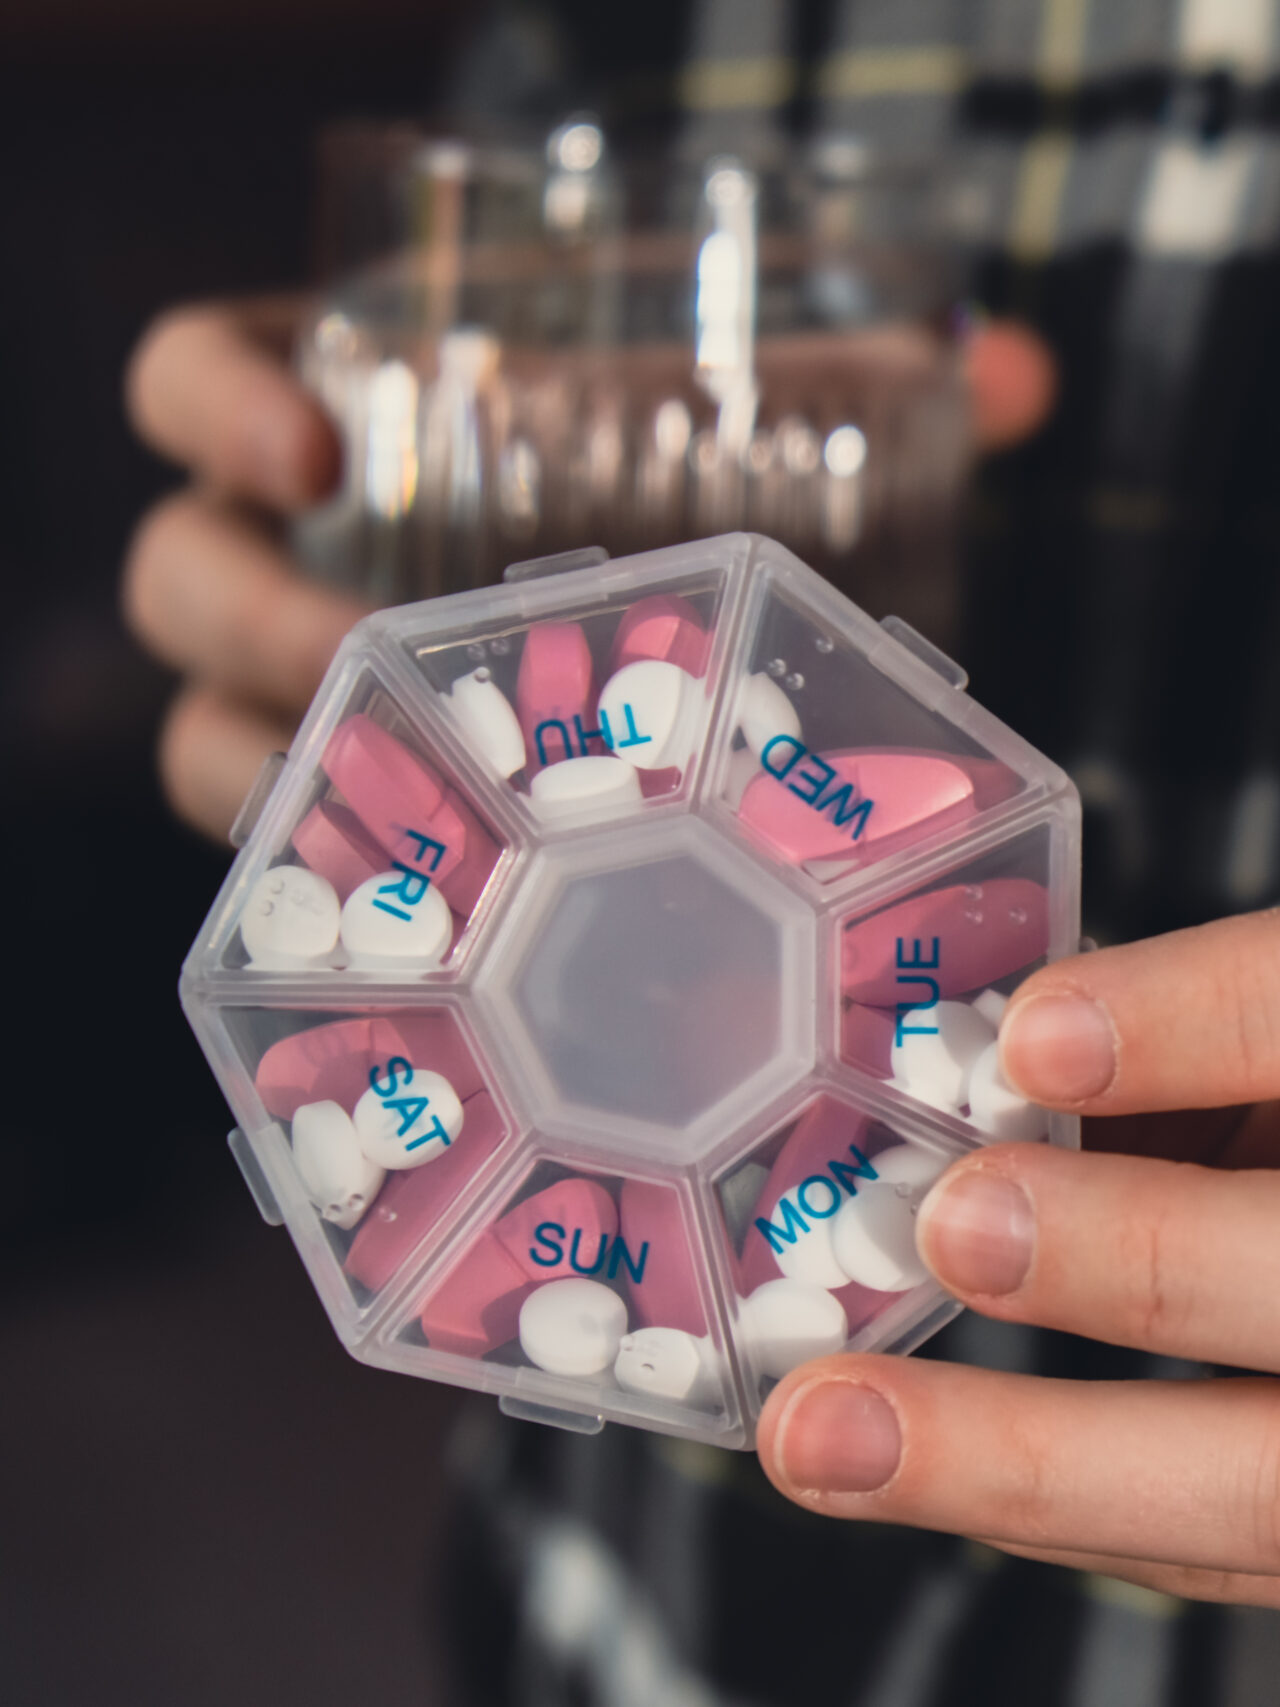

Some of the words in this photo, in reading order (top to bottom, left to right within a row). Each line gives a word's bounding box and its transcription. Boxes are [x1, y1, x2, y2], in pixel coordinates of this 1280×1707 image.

[533, 703, 652, 765] THU
[760, 734, 874, 841] WED
[372, 829, 447, 922] FRI
[895, 936, 940, 1047] TUE
[368, 1056, 451, 1152] SAT
[755, 1144, 879, 1255] MON
[529, 1222, 650, 1284] SUN
